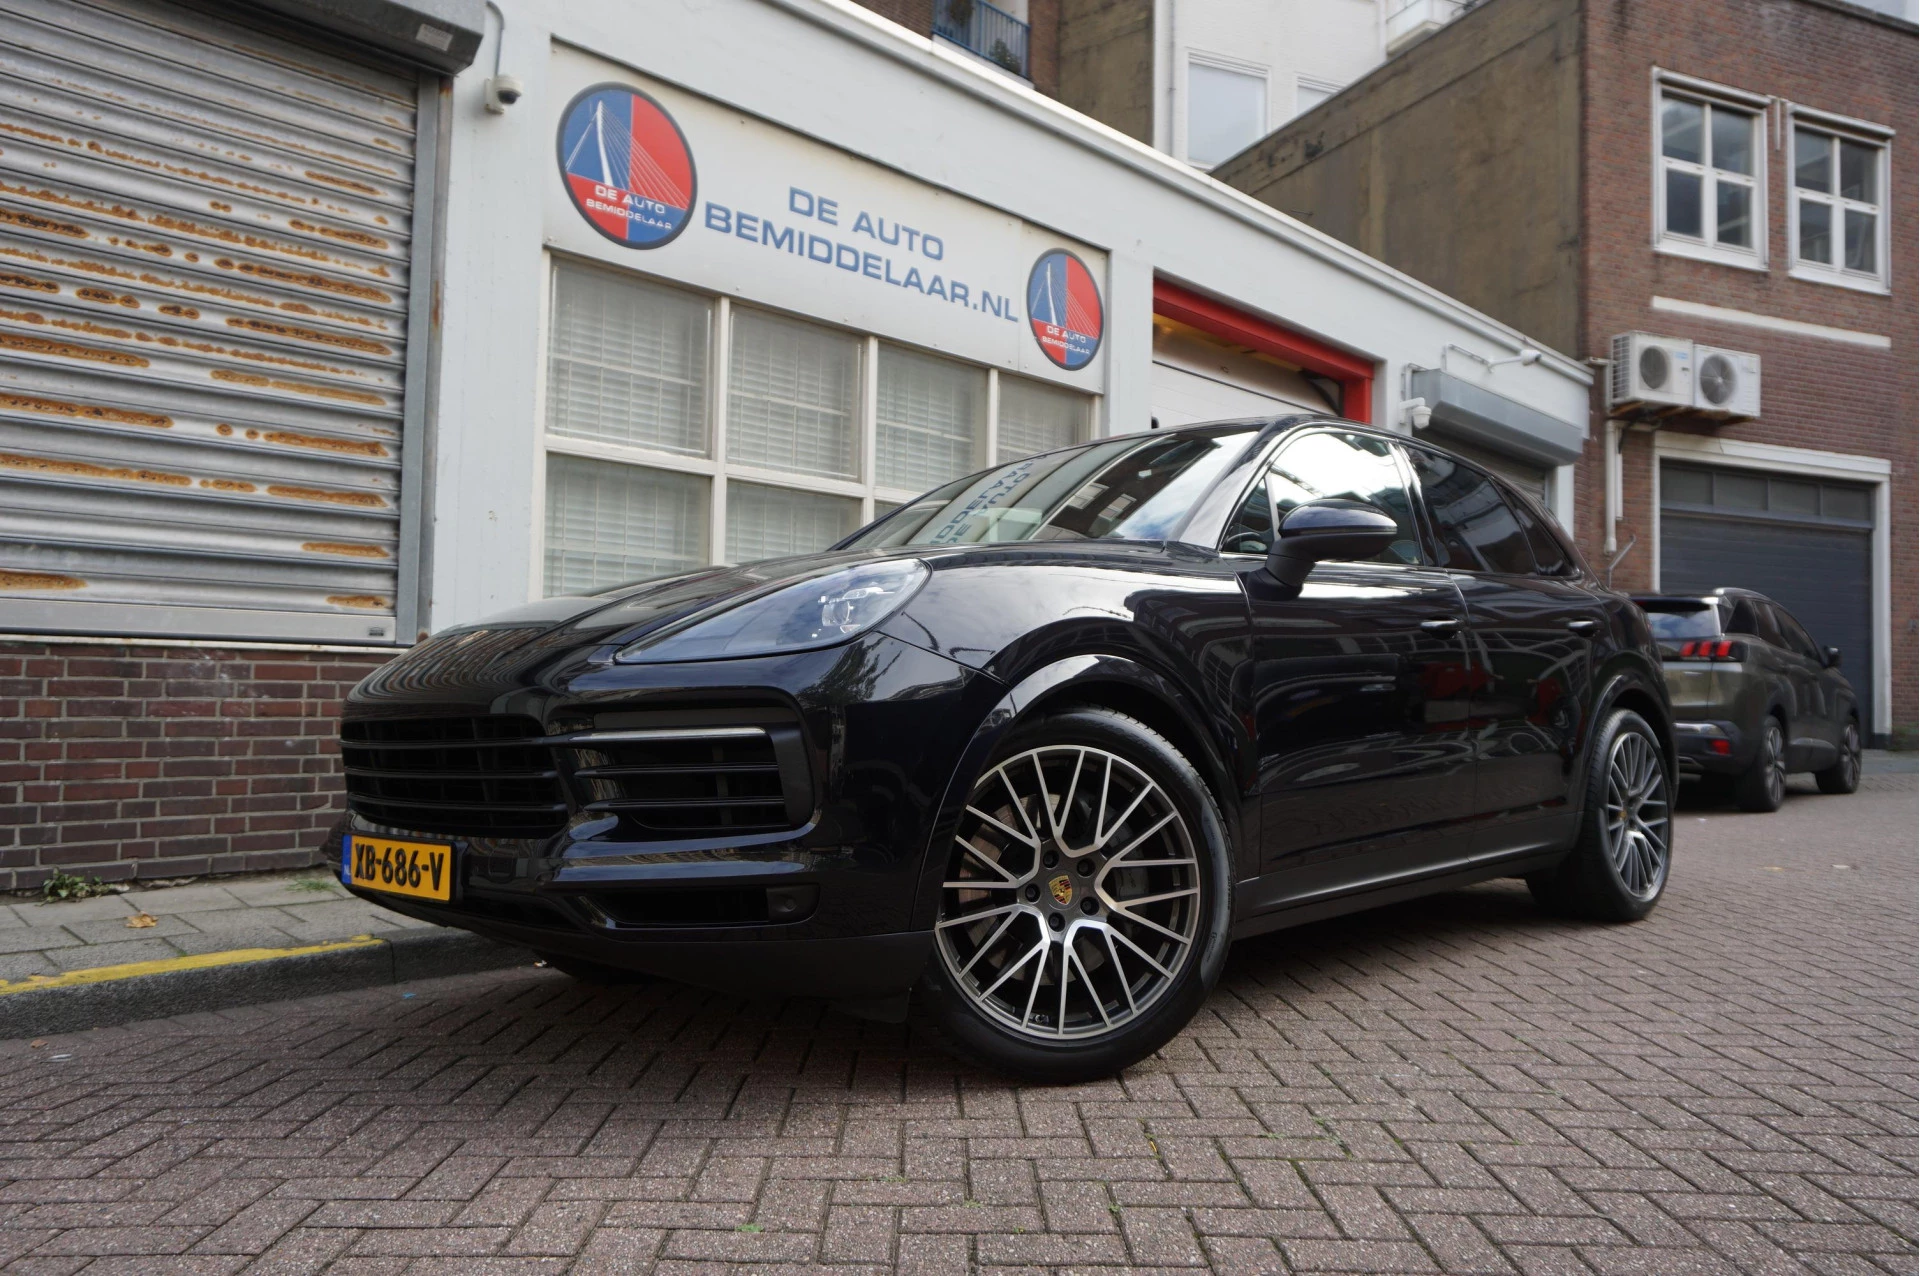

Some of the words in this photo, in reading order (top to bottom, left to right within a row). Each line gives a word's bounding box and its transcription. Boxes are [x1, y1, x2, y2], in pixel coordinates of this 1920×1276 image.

[585, 198, 673, 230] BEMIDDELAAR
[594, 184, 618, 200] DE
[622, 194, 666, 214] AUTO
[789, 186, 838, 226] DE
[851, 211, 944, 261] AUTO
[704, 201, 1019, 323] BEMIDDELAAR.NL
[1041, 335, 1091, 354] BEMIDDELAAR
[1046, 325, 1060, 336] DE
[1062, 330, 1086, 344] AUTO
[354, 843, 445, 892] XB-686-V
